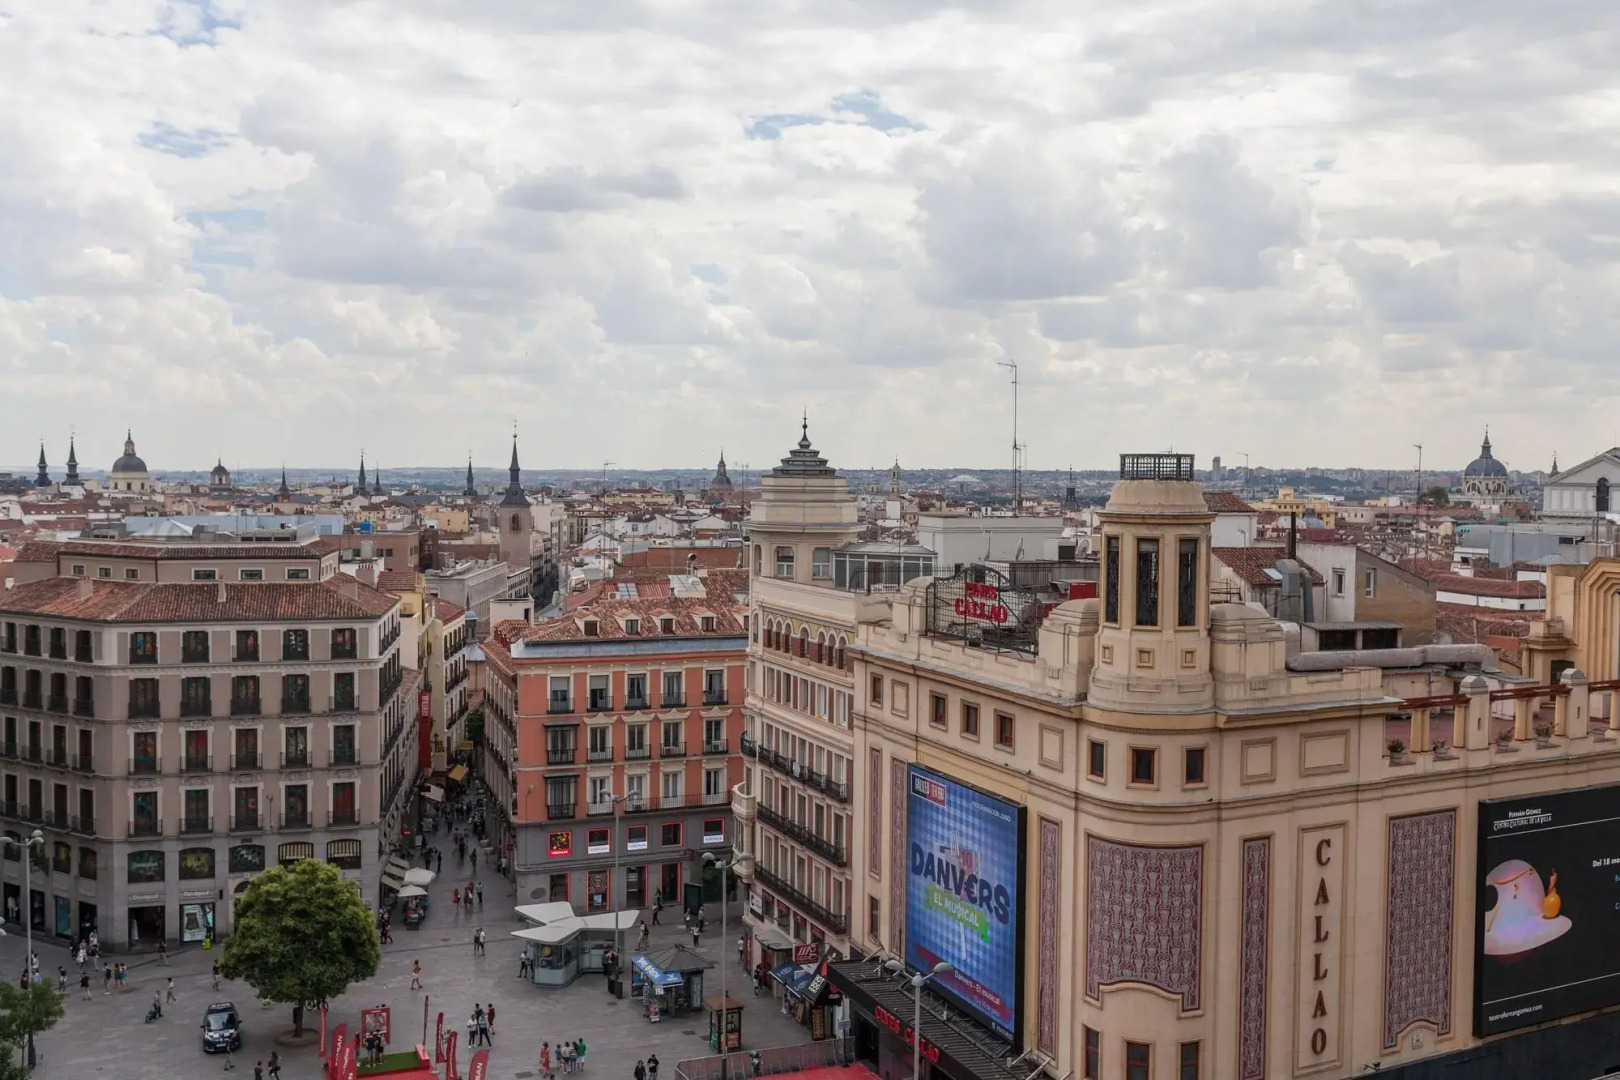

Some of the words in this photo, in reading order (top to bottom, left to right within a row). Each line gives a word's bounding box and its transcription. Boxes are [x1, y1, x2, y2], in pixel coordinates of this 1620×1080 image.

[955, 598, 1008, 623] CALLAO
[1592, 859, 1602, 868] Del
[1603, 857, 1611, 866] 18
[933, 892, 943, 907] EL
[1311, 838, 1331, 1055] CALLAO
[954, 970, 974, 988] Danvers
[975, 983, 982, 994] El
[982, 988, 1000, 1006] musical
[874, 1005, 901, 1034] CINES
[904, 1027, 940, 1063] CALAO
